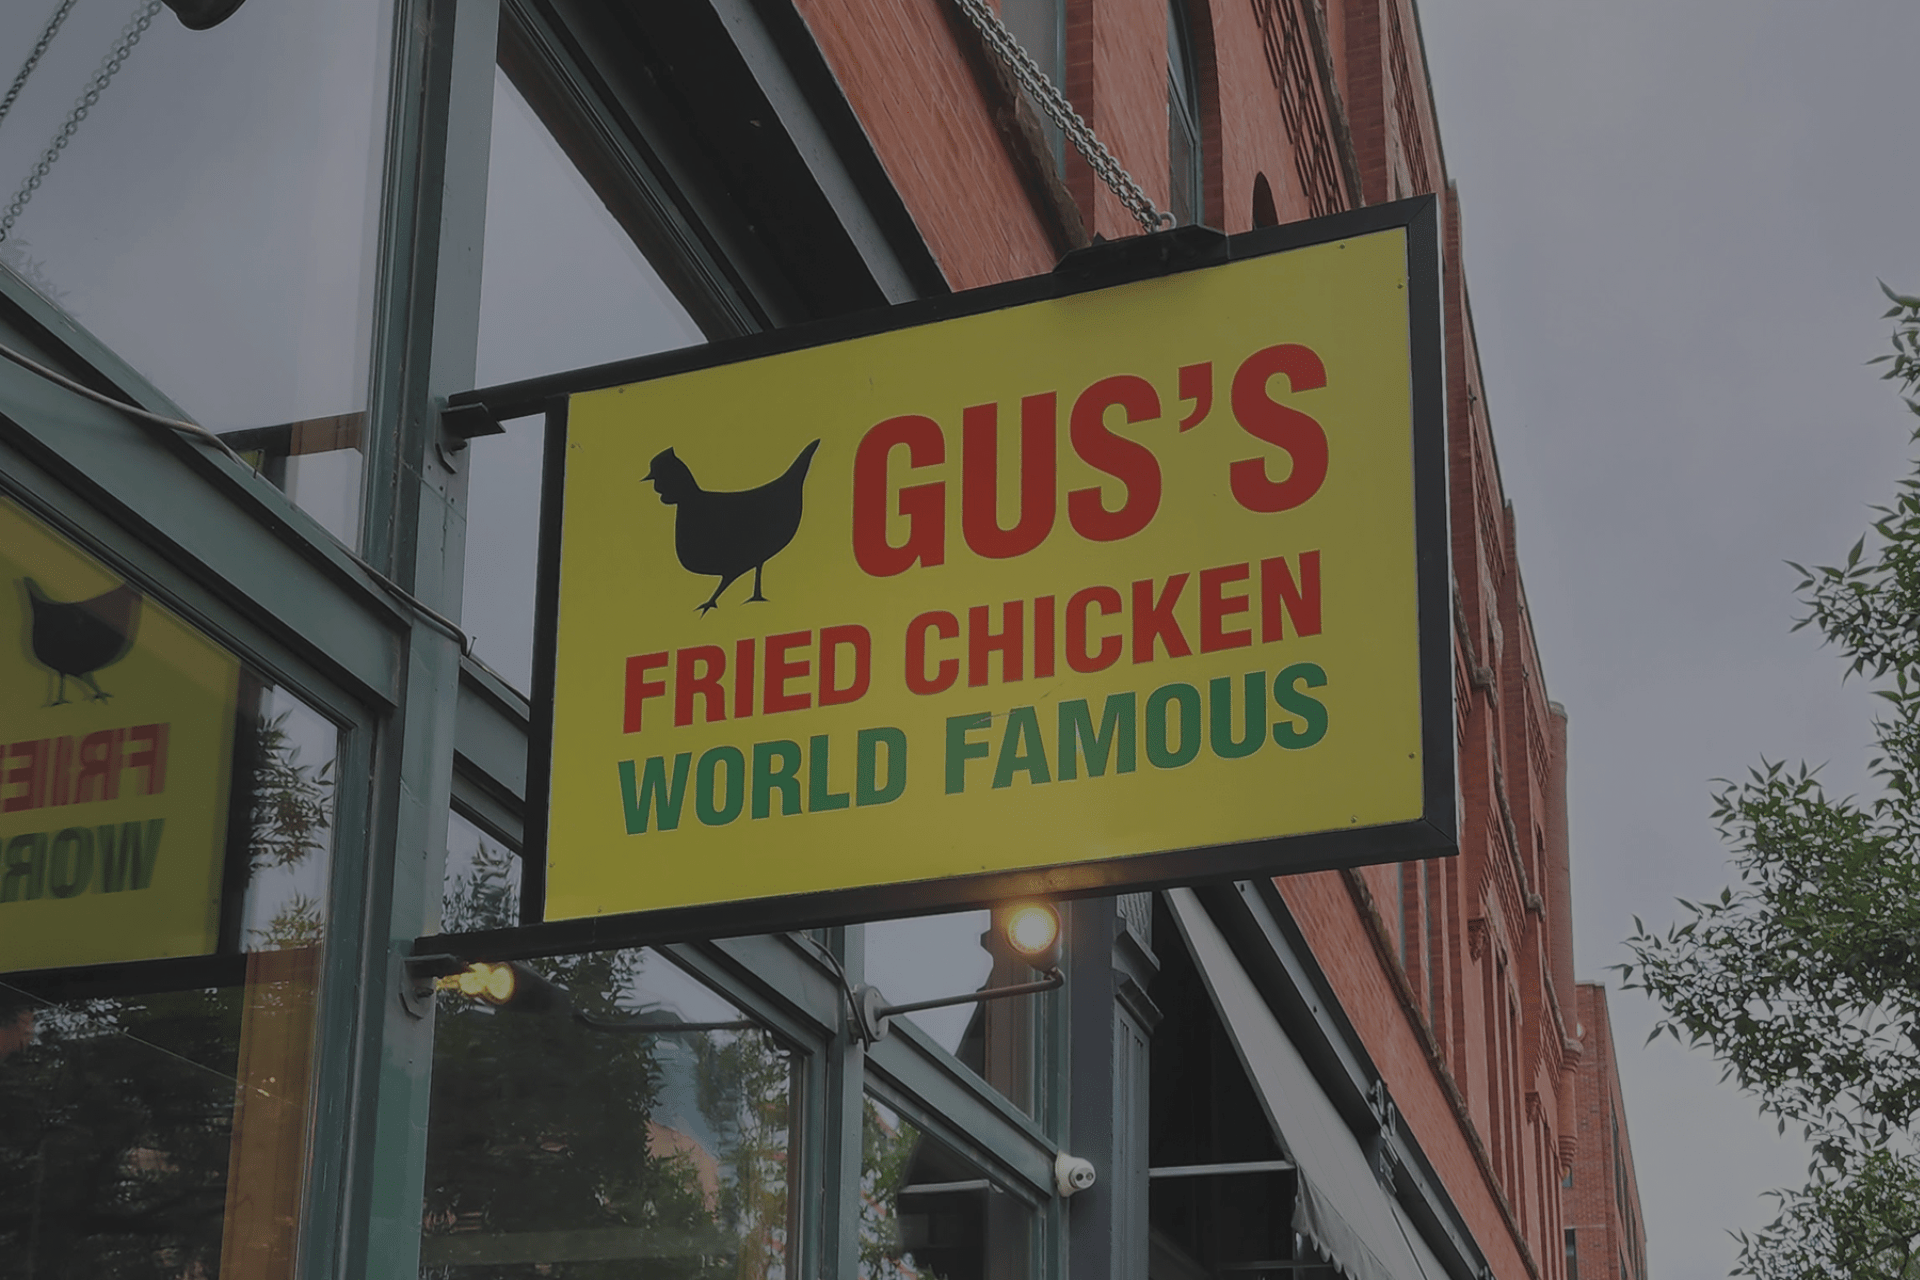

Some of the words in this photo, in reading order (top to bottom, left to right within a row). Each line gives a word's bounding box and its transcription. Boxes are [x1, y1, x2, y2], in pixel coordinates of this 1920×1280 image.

[854, 345, 1328, 577] GUS'S
[624, 625, 870, 733] FRIED
[906, 551, 1322, 694] CHICKEN
[619, 728, 907, 835] WORLD
[946, 663, 1328, 794] FAMOUS
